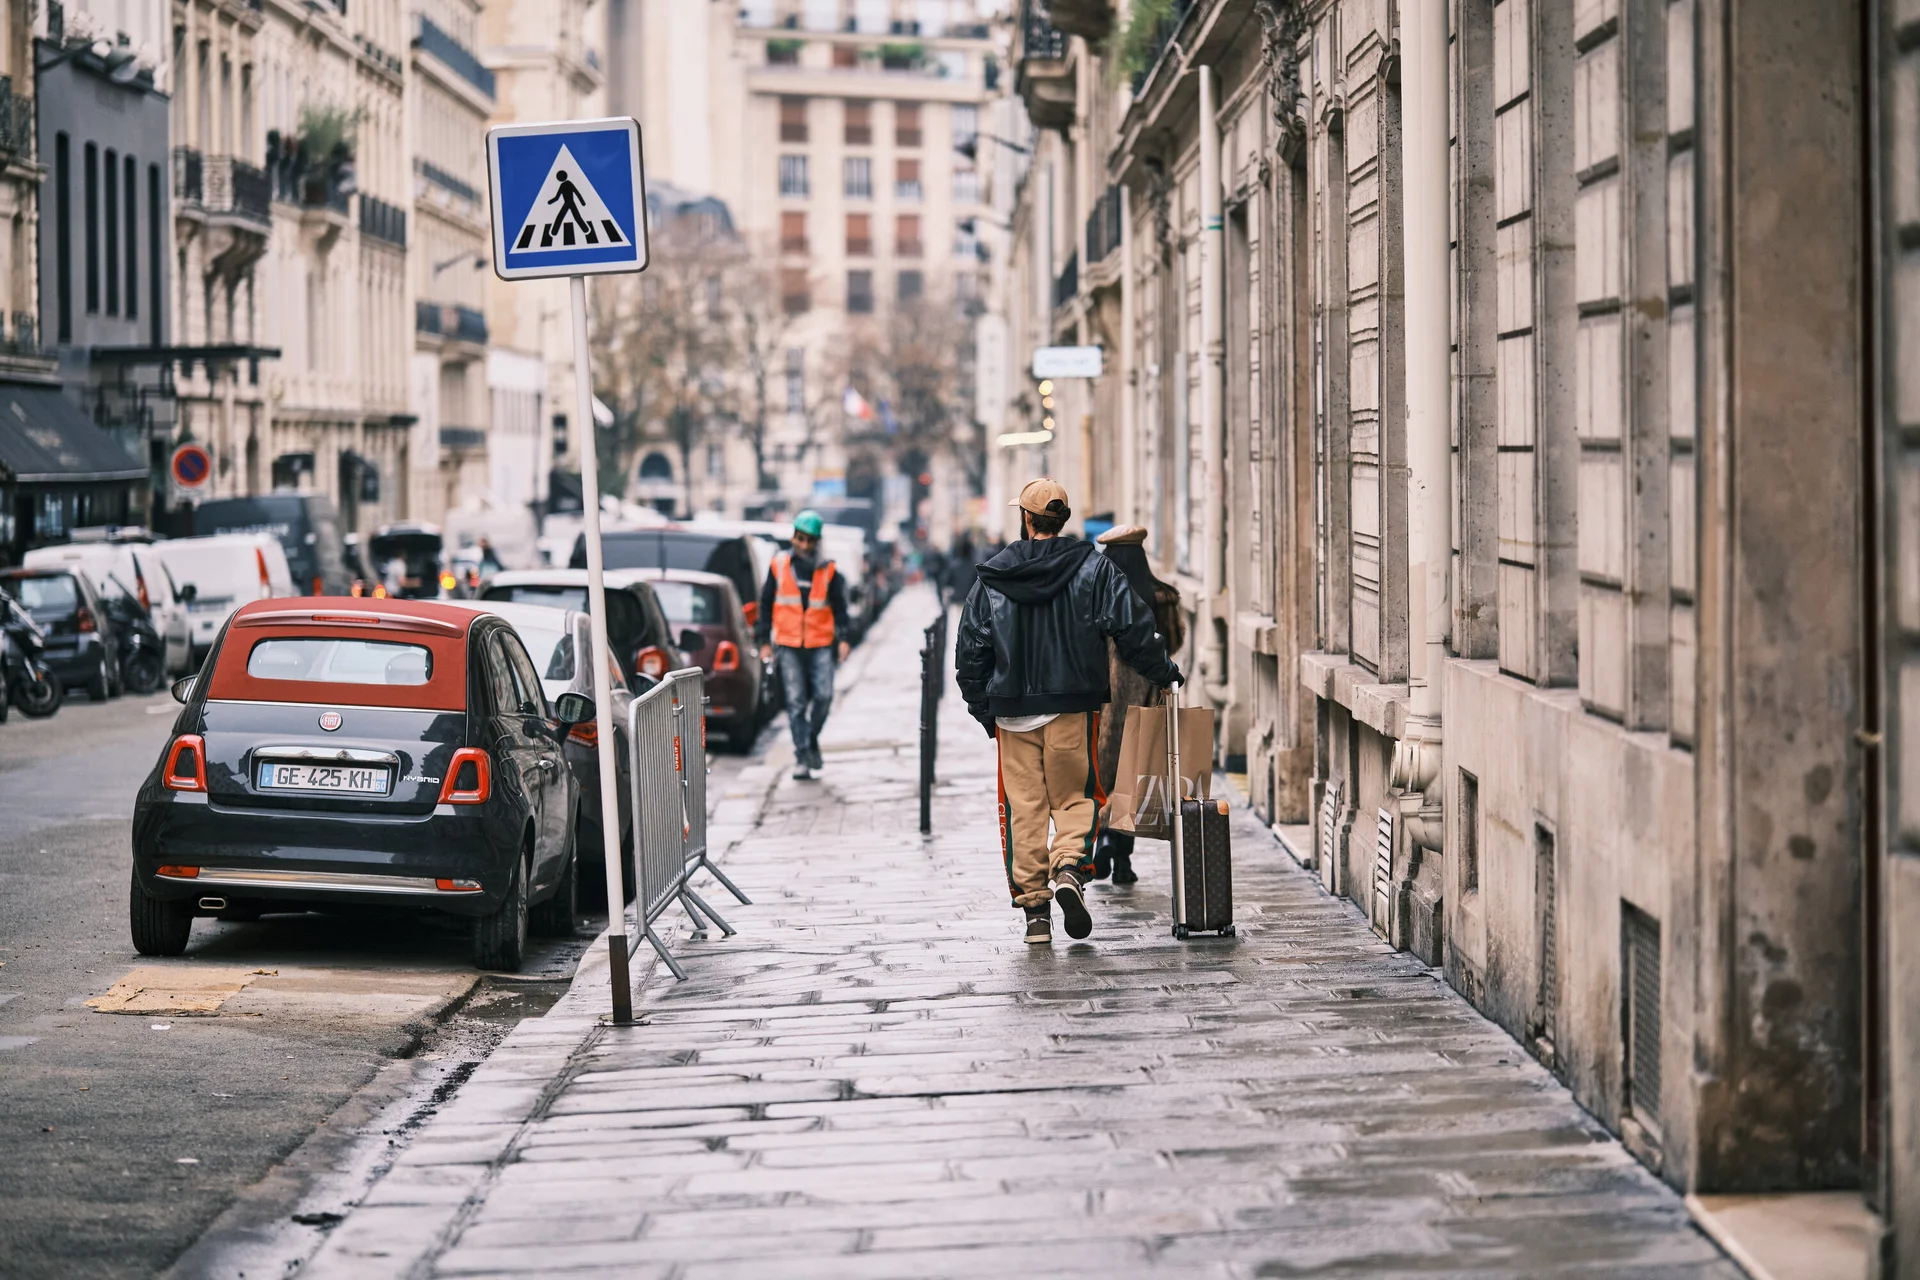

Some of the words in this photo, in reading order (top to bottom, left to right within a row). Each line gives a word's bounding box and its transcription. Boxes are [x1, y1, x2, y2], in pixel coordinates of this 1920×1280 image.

[324, 716, 338, 726] FIAT
[277, 767, 373, 789] GE-425-KH
[375, 781, 387, 790] 60
[403, 775, 440, 784] HYBRID
[1135, 774, 1205, 826] ZA
